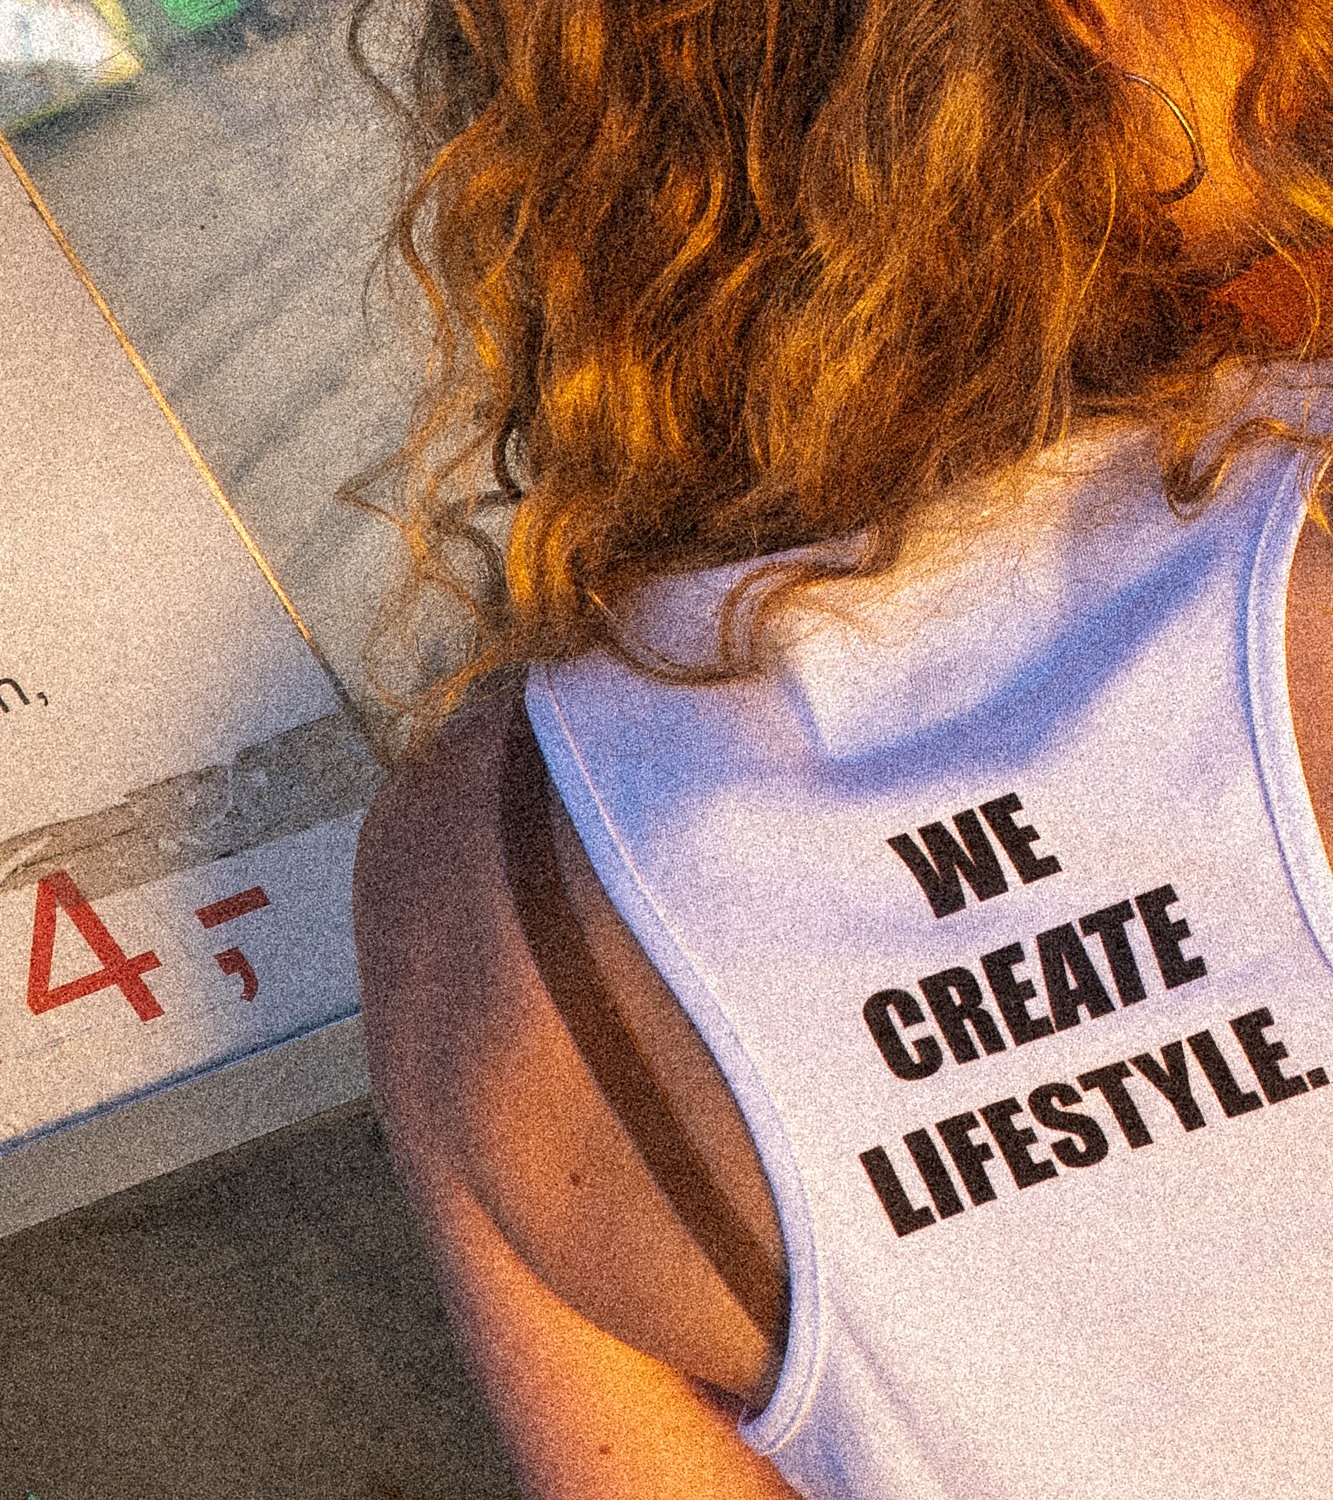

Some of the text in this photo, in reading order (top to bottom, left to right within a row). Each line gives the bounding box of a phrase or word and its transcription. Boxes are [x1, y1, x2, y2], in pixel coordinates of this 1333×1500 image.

[886, 792, 1062, 919] WE
[862, 883, 1208, 1082] CREATE
[858, 1006, 1331, 1238] LIFESTYLE.
